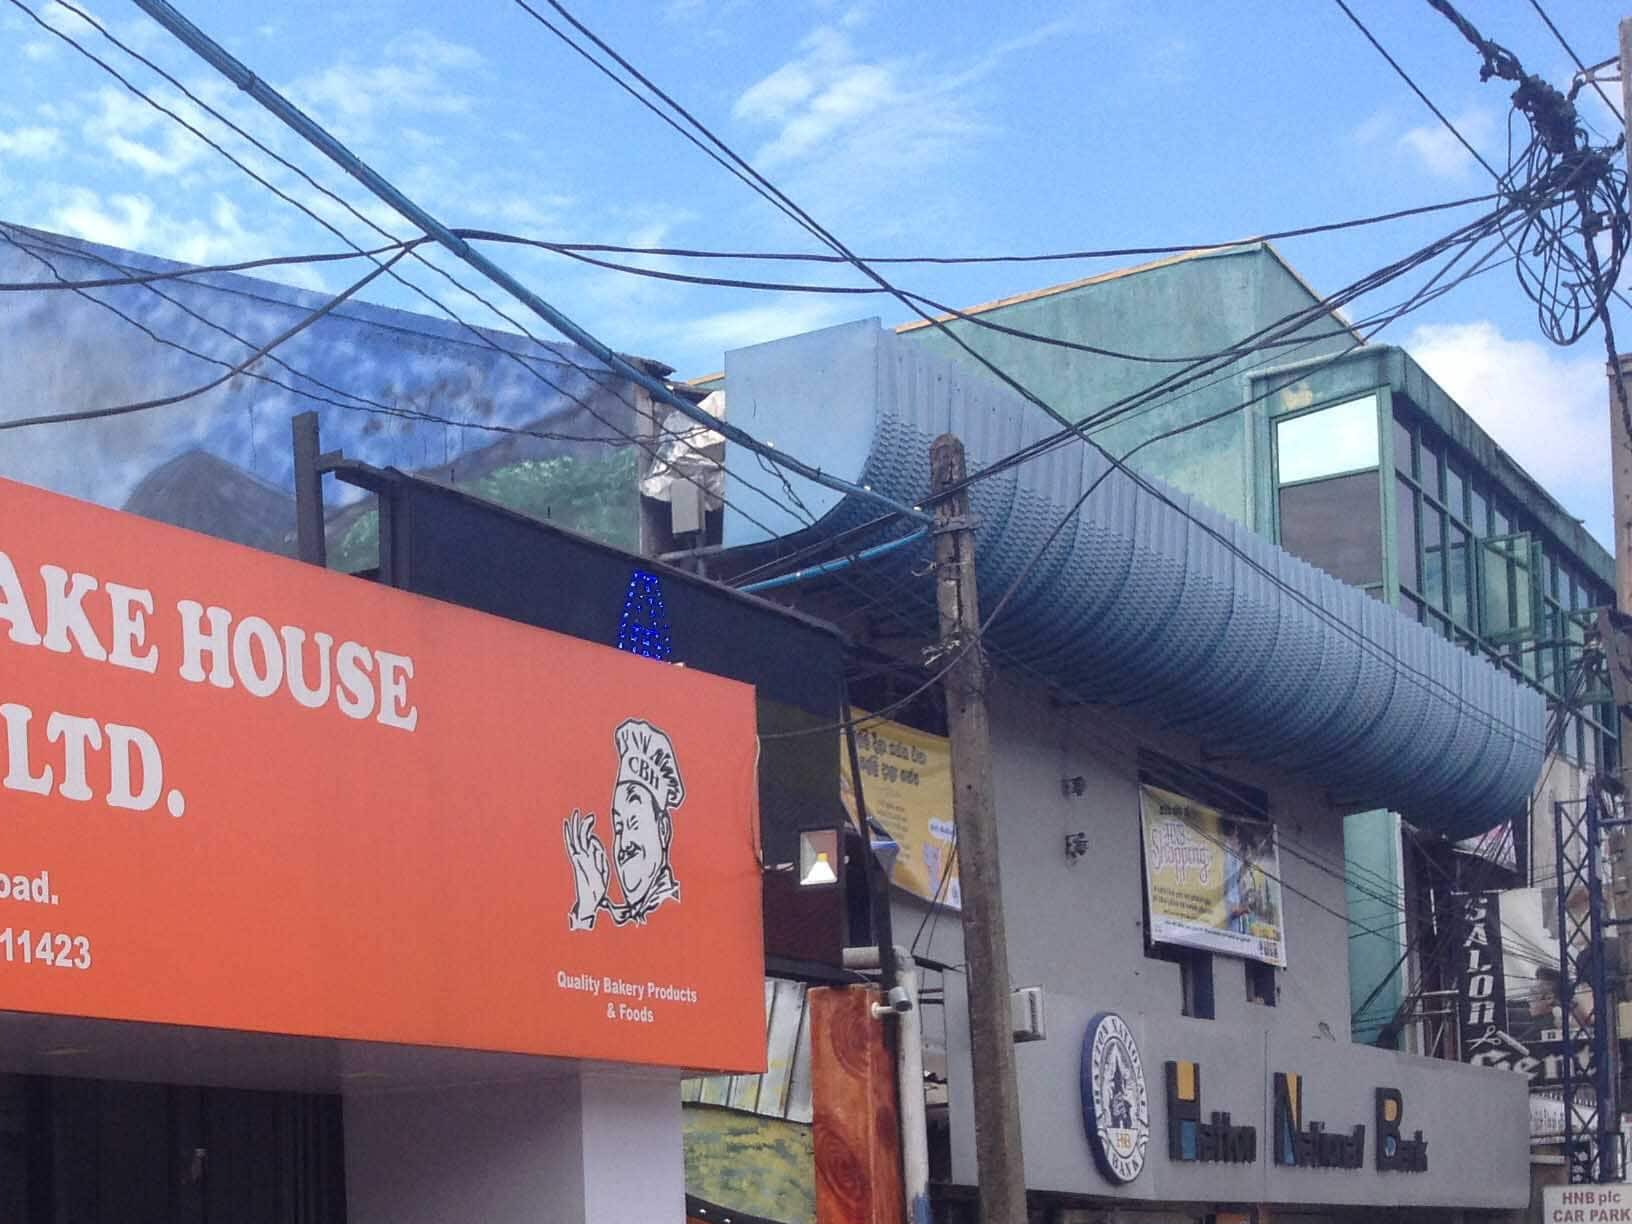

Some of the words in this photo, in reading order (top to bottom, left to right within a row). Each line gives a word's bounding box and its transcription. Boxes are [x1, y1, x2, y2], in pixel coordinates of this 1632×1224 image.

[176, 599, 418, 732] HOUSE
[0, 703, 186, 818] LTD.
[628, 756, 660, 790] CBH
[556, 970, 601, 995] Quality
[603, 976, 645, 999] Bakery
[647, 981, 698, 1004] Products
[607, 1003, 616, 1019] &
[619, 1005, 655, 1024] Foods
[1562, 1191, 1595, 1206] HNB
[1552, 1210, 1585, 1224] CAR
[1589, 1209, 1631, 1224] PARK
